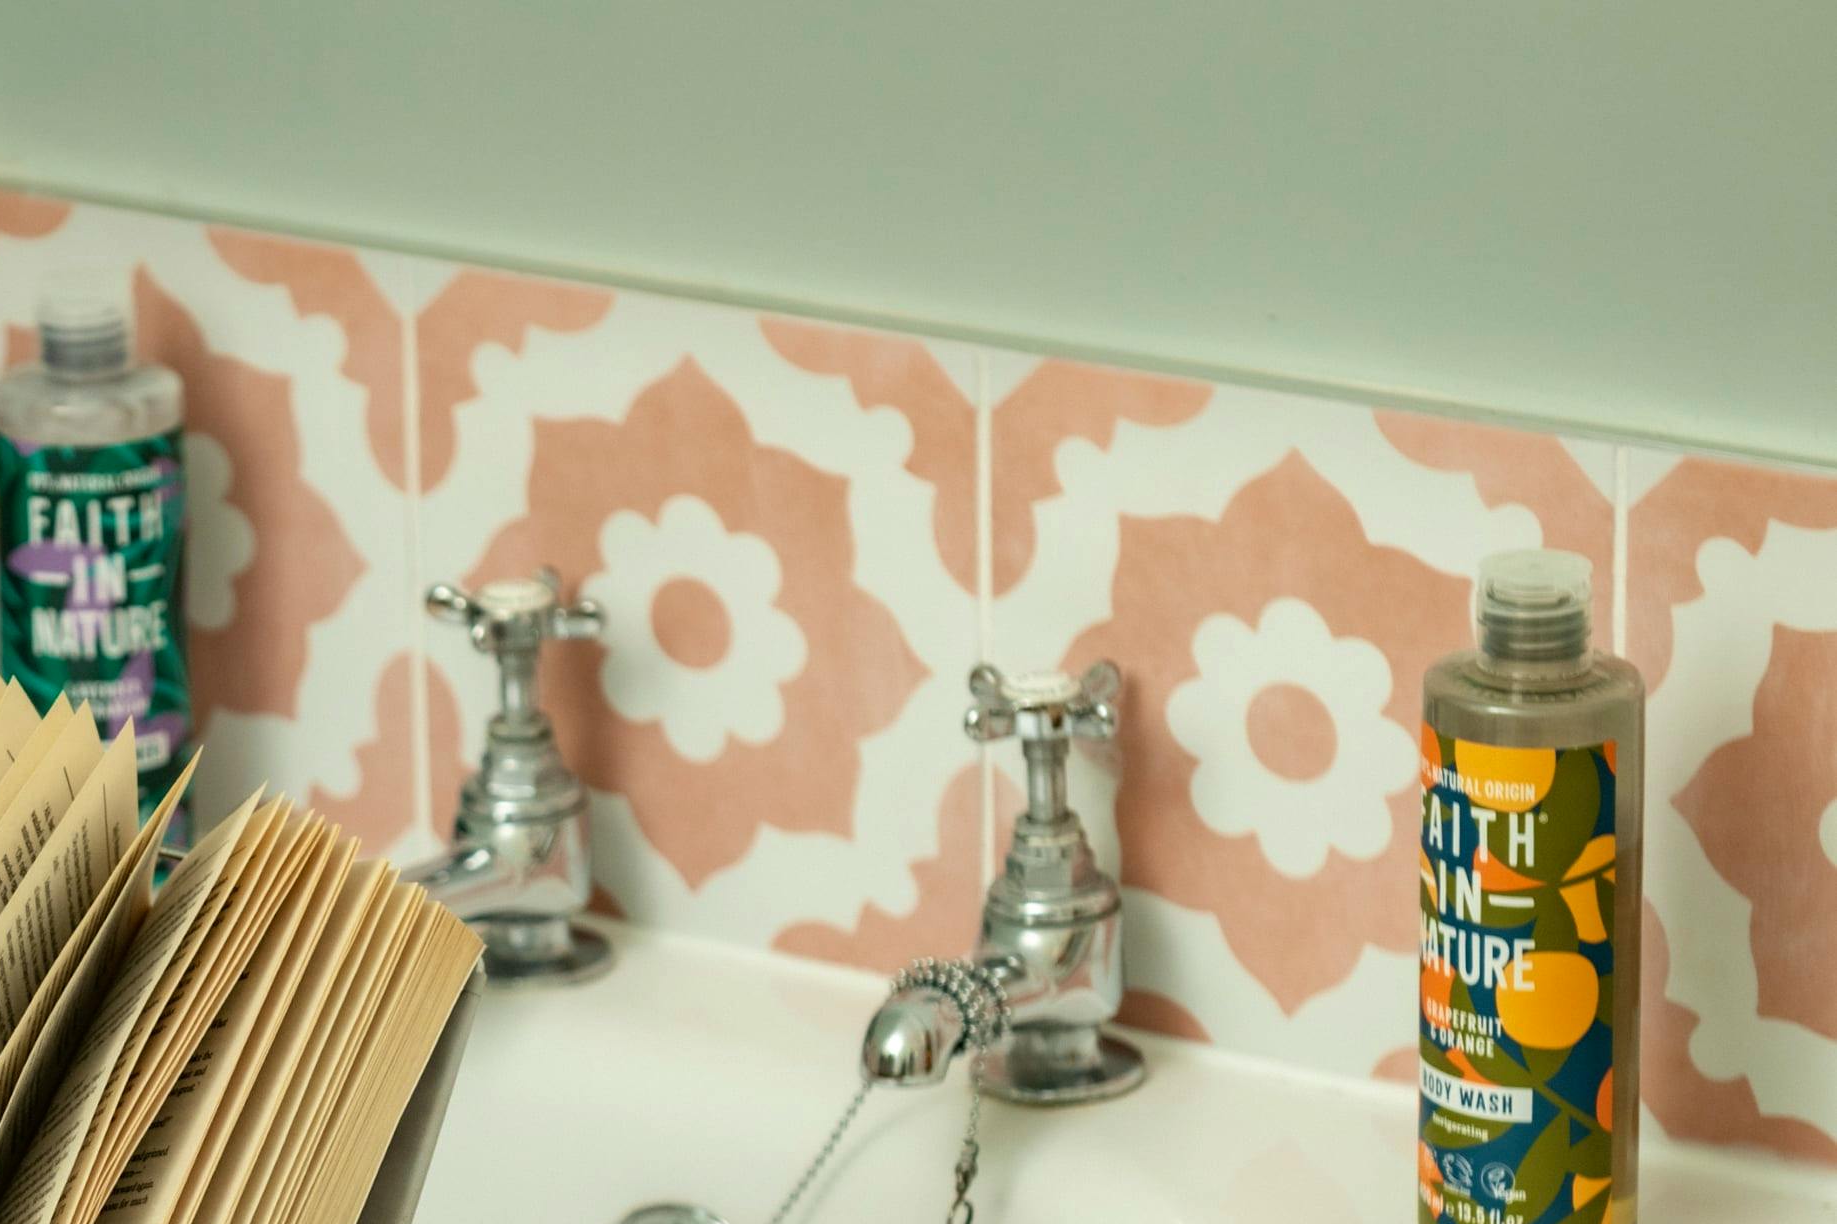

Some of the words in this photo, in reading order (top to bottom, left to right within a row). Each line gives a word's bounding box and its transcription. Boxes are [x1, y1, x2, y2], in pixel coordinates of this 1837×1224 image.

[27, 490, 163, 549] FAITH
[72, 552, 127, 606] IN
[31, 600, 168, 660] NATURE
[1431, 761, 1482, 798] NATURAL
[1484, 779, 1536, 802] ORIGIN
[1439, 858, 1482, 924] IN
[1421, 909, 1536, 992] NATURE
[1426, 996, 1503, 1038] GRAPEFRUIT
[1440, 1025, 1496, 1058] ORANGE
[1422, 1067, 1452, 1104] BODY
[1459, 1085, 1513, 1115] WASH
